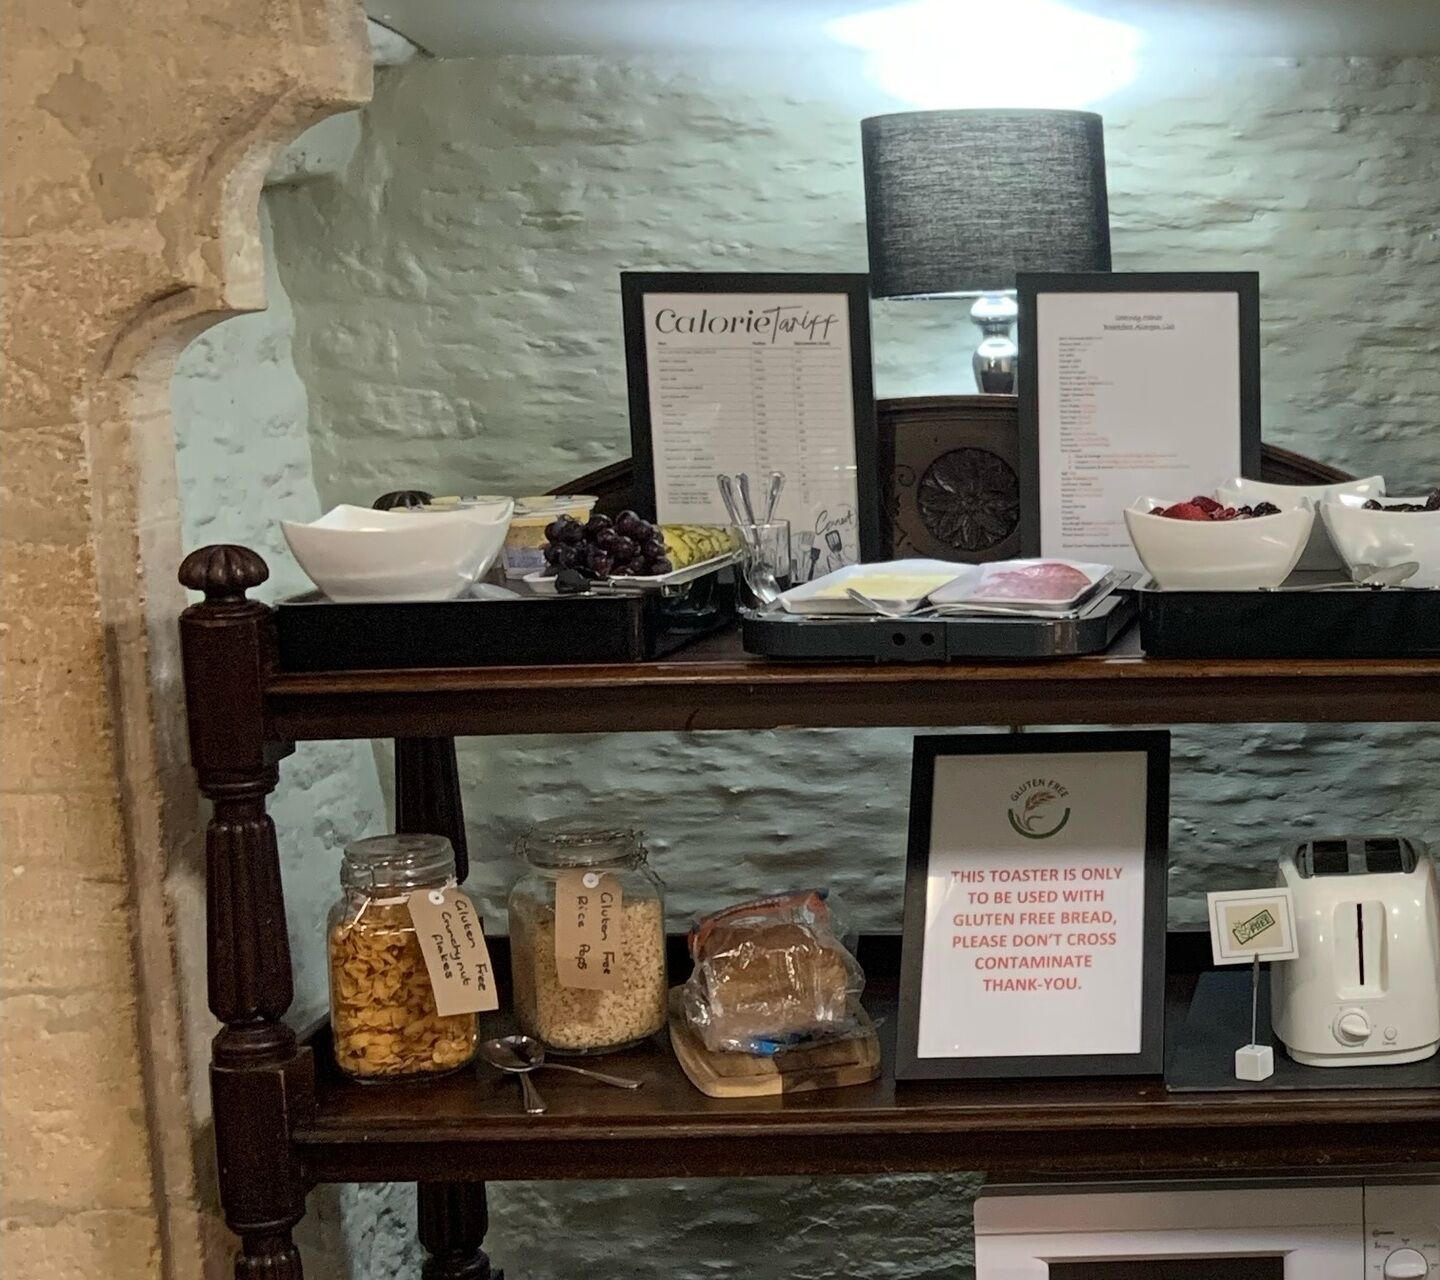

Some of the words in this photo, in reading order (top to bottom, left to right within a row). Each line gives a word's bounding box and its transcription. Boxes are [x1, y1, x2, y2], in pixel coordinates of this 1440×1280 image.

[655, 308, 771, 334] Calorie
[763, 305, 840, 344] Tariff
[1010, 778, 1046, 802] GLUTEN
[1048, 779, 1070, 798] FREE
[951, 870, 985, 883] THIS
[989, 869, 1059, 883] TOASTER
[1064, 869, 1077, 881] IS
[1081, 867, 1123, 881] ONLY
[968, 892, 989, 904] TO
[994, 891, 1013, 904] BE
[1017, 890, 1058, 904] USED
[1062, 889, 1105, 902] WITH
[576, 895, 589, 928] Rice
[600, 892, 614, 941] Gluten
[953, 913, 1015, 927] GLUTEN
[1020, 912, 1056, 925] FREE
[1061, 911, 1117, 926] BREAD,
[455, 899, 476, 949] Gluten
[475, 963, 489, 992] Free
[952, 935, 1007, 949] PLEASE
[1012, 933, 1062, 947] DON'T
[1067, 932, 1117, 946] CROSS
[602, 951, 615, 975] Free
[974, 955, 1093, 970] CONTAMINATE
[983, 977, 1082, 992] THANK-YOU.
